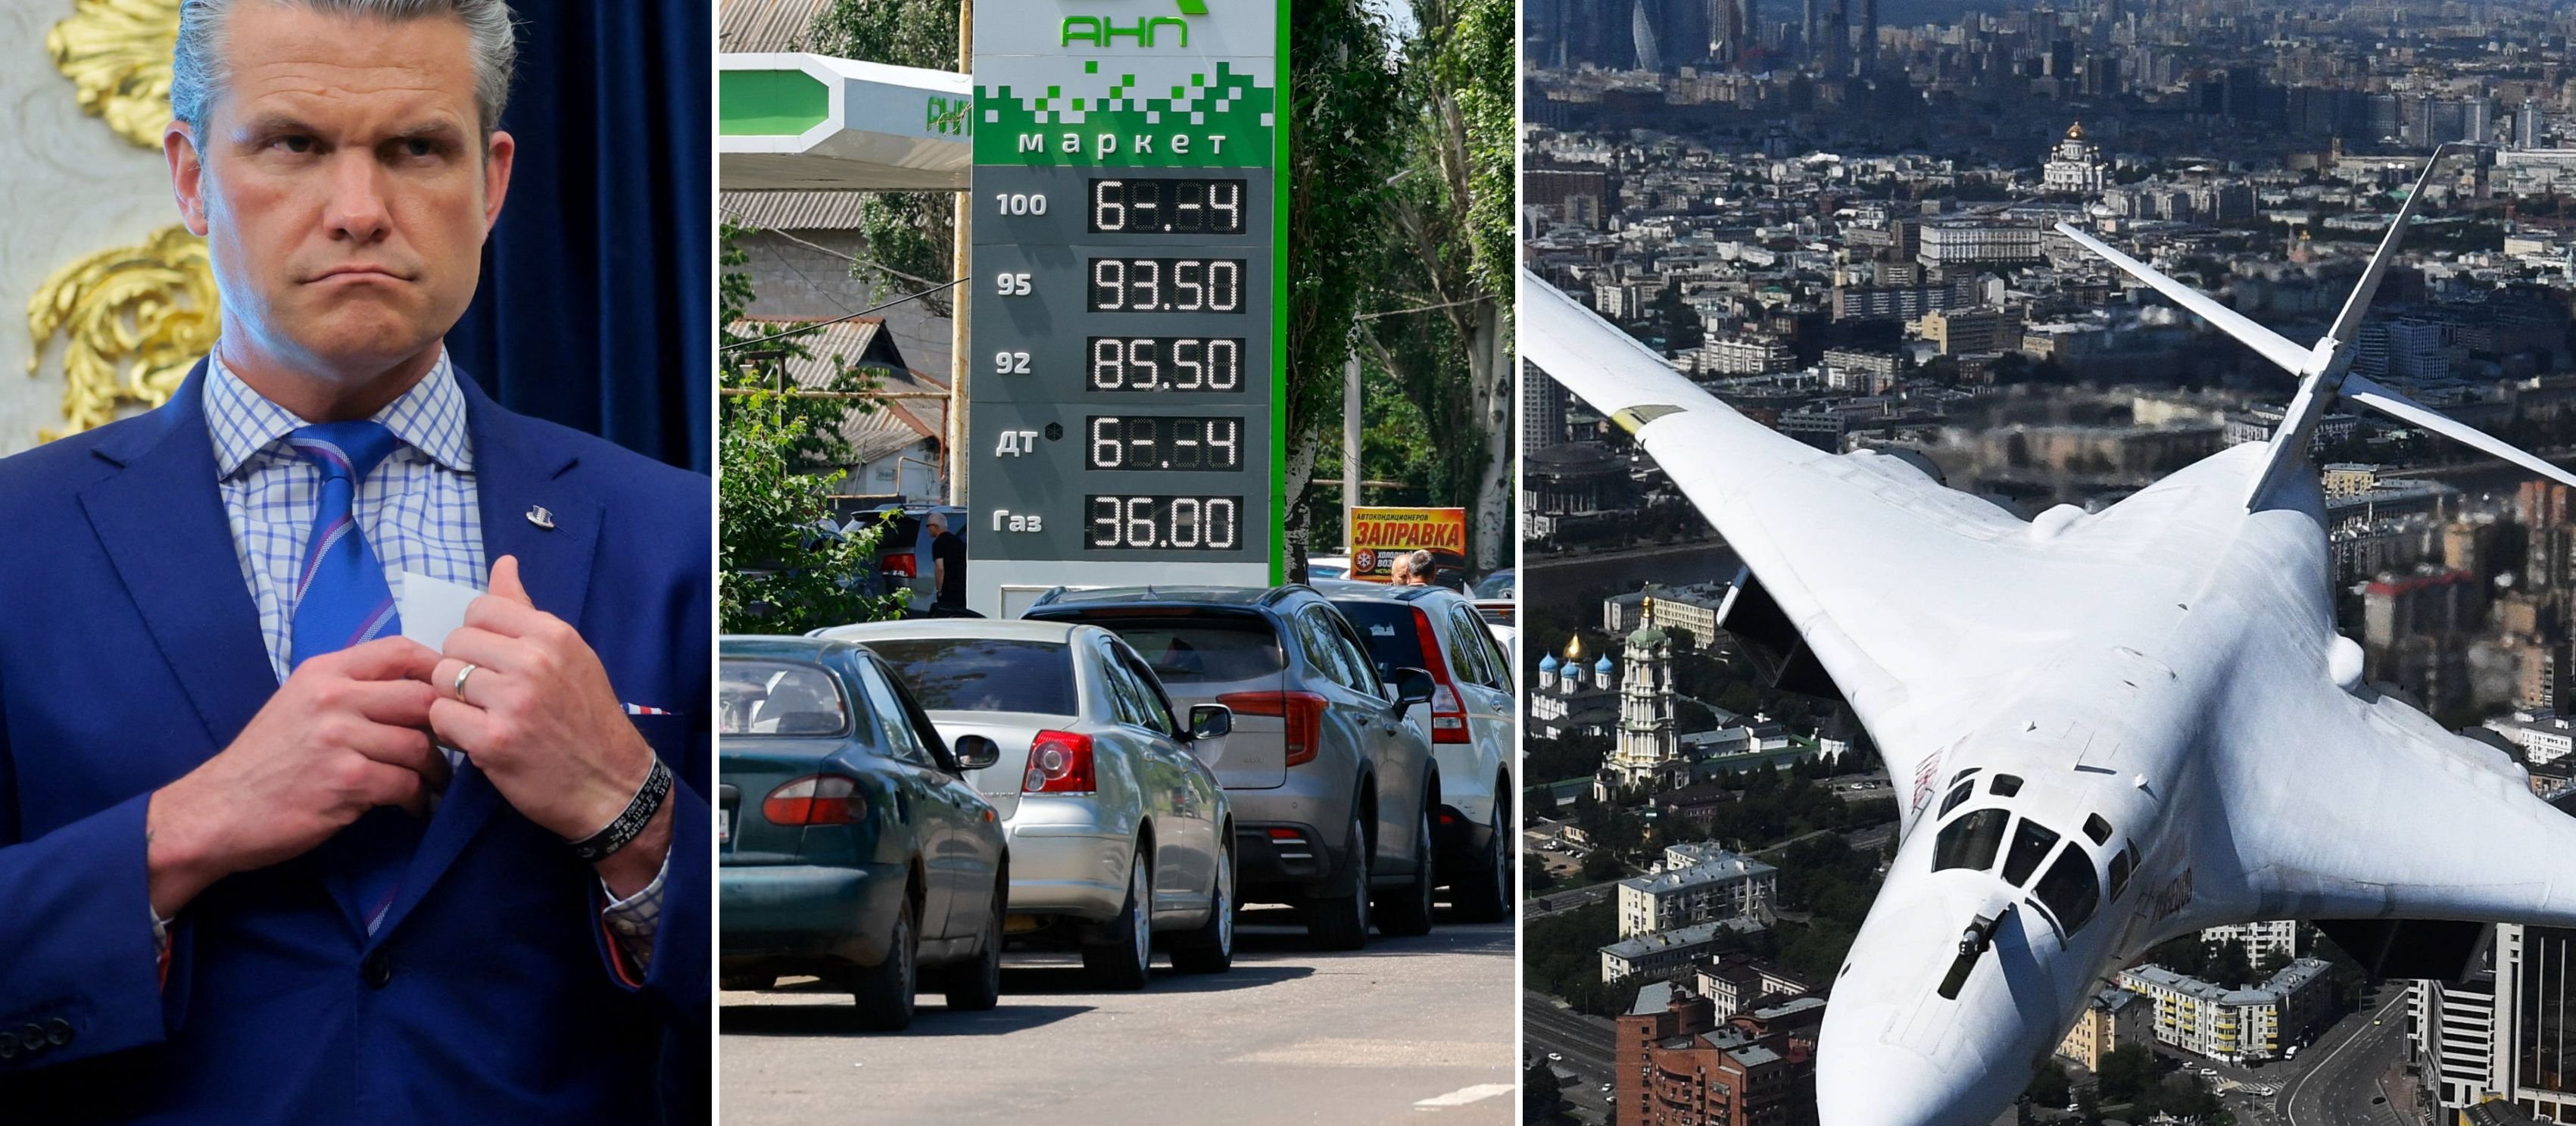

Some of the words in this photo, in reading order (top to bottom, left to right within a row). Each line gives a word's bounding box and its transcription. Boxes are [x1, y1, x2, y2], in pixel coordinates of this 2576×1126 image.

[1061, 16, 1187, 47] АНП
[1018, 133, 1227, 161] маркет
[996, 194, 1047, 216] 100
[997, 273, 1032, 296] 95
[1096, 260, 1238, 310] 93.50
[996, 352, 1031, 375] 92
[1094, 338, 1237, 389] 85.50
[996, 431, 1038, 457] ДТ
[993, 510, 1043, 532] Газ
[1094, 497, 1235, 547] 36.00
[1354, 522, 1460, 546] ЗАПРАВКА
[1377, 559, 1392, 567] ВОЗ
